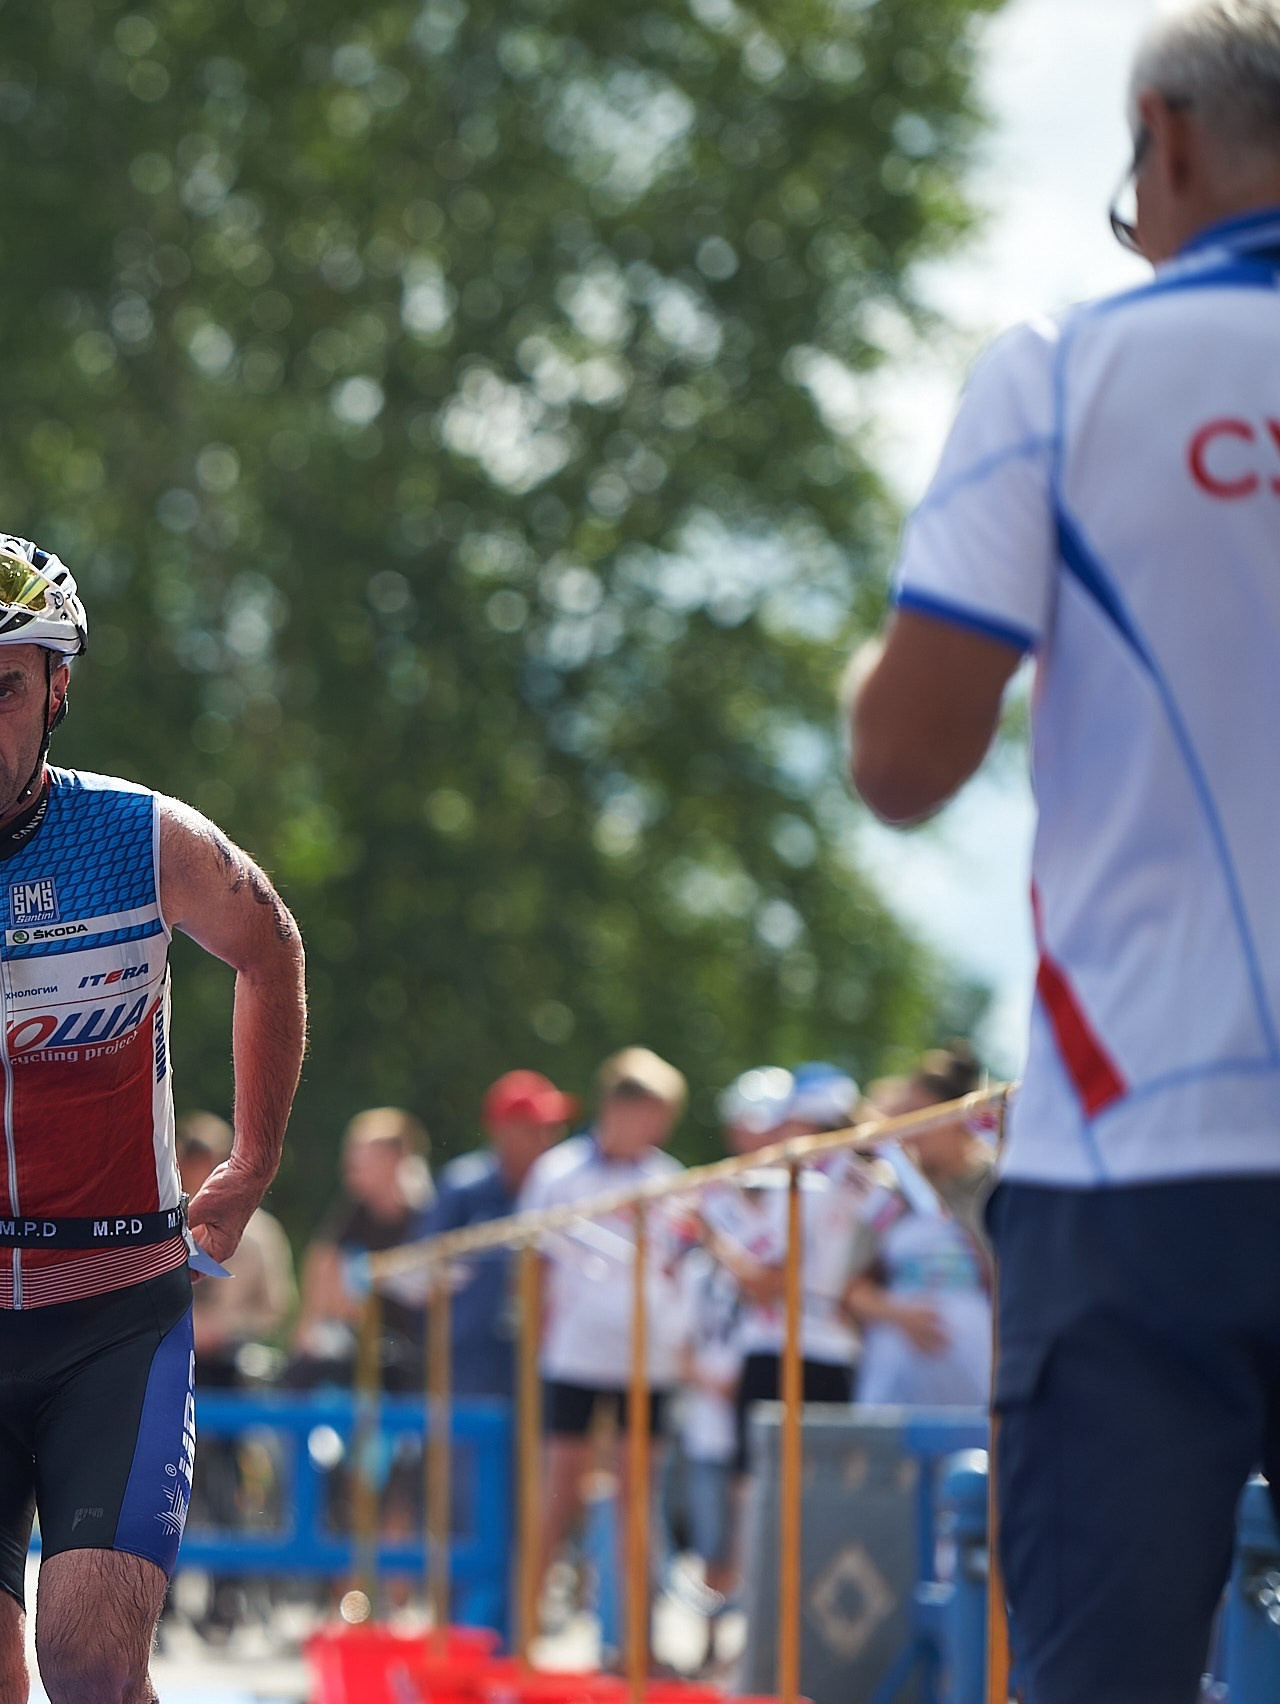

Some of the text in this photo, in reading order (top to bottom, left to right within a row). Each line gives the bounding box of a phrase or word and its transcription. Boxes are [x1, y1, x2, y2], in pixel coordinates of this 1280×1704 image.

[16, 911, 55, 924] Santini
[33, 924, 89, 940] ŠKODA
[78, 963, 149, 989] ITERA
[85, 1030, 139, 1061] project
